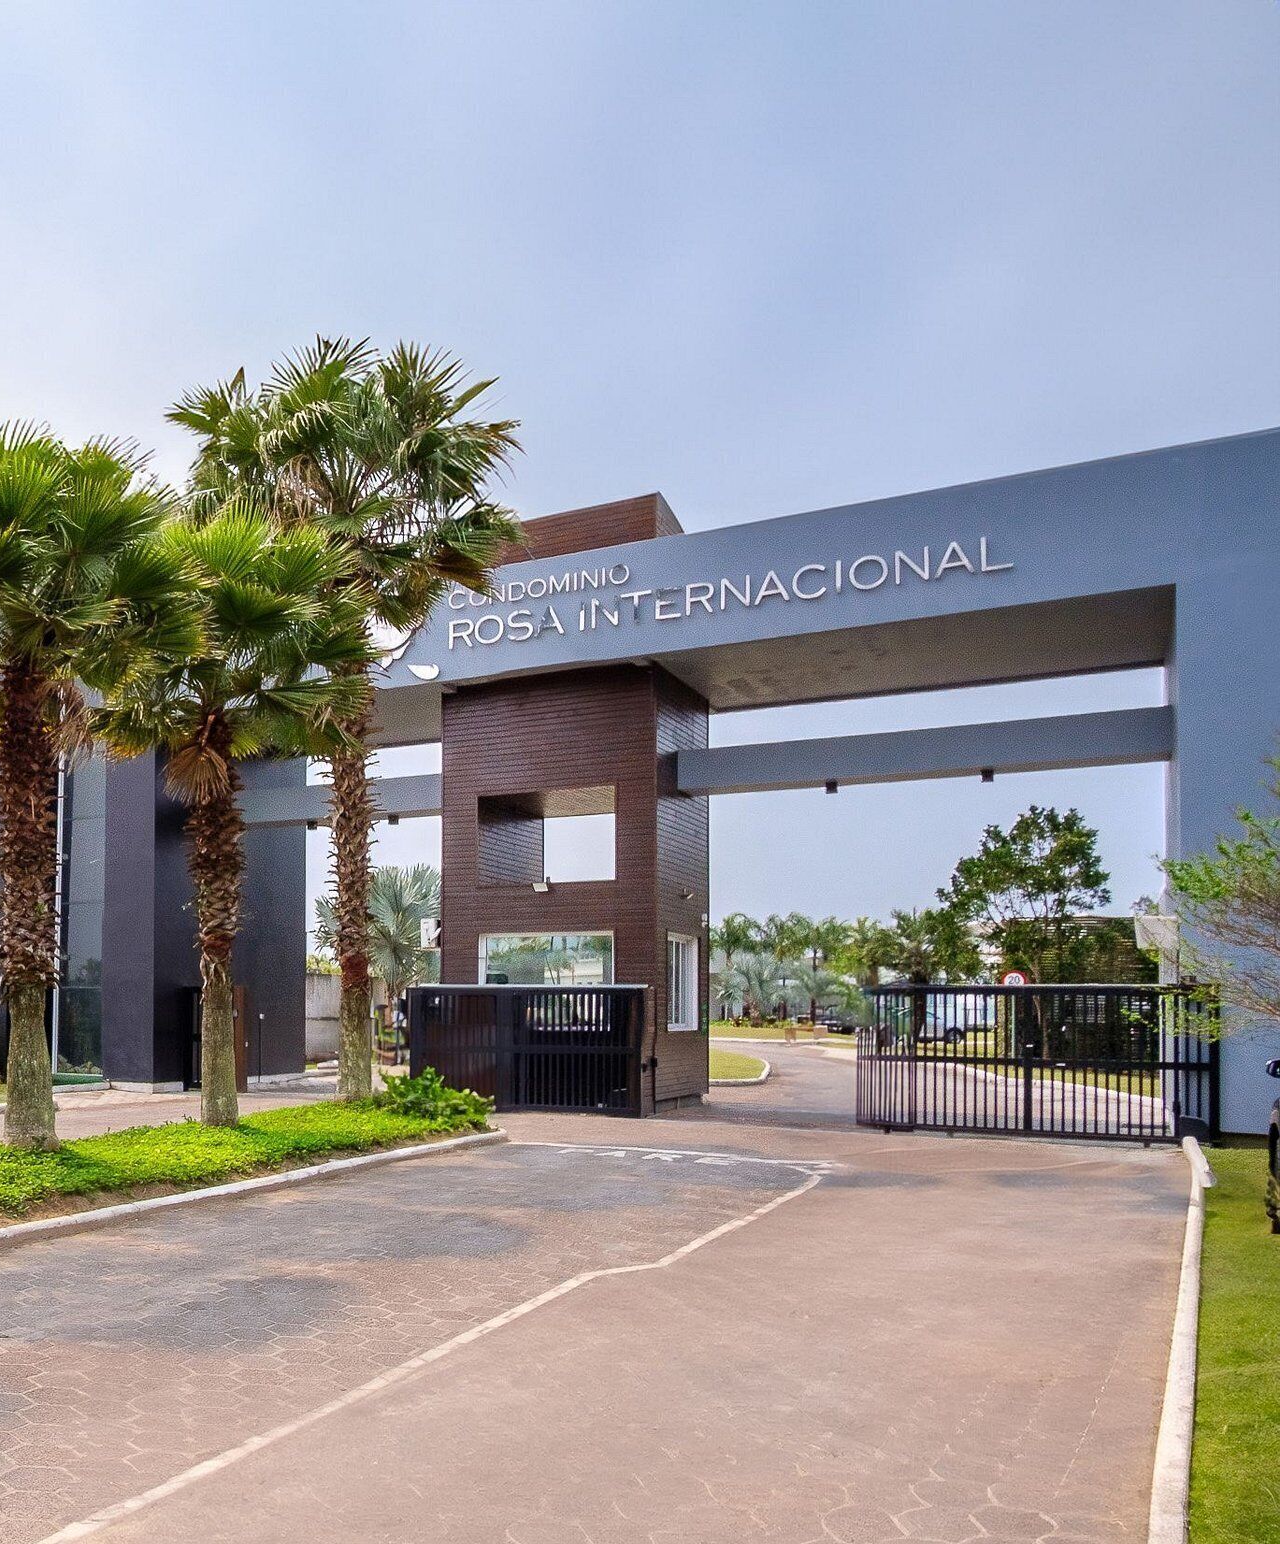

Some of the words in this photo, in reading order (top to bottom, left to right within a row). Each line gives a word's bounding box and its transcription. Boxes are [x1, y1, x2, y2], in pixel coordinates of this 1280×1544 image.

[447, 604, 565, 650] ROSA
[578, 536, 1014, 632] INTERNACIONAL
[448, 563, 630, 610] CONDOMINIO
[1008, 975, 1021, 985] 20
